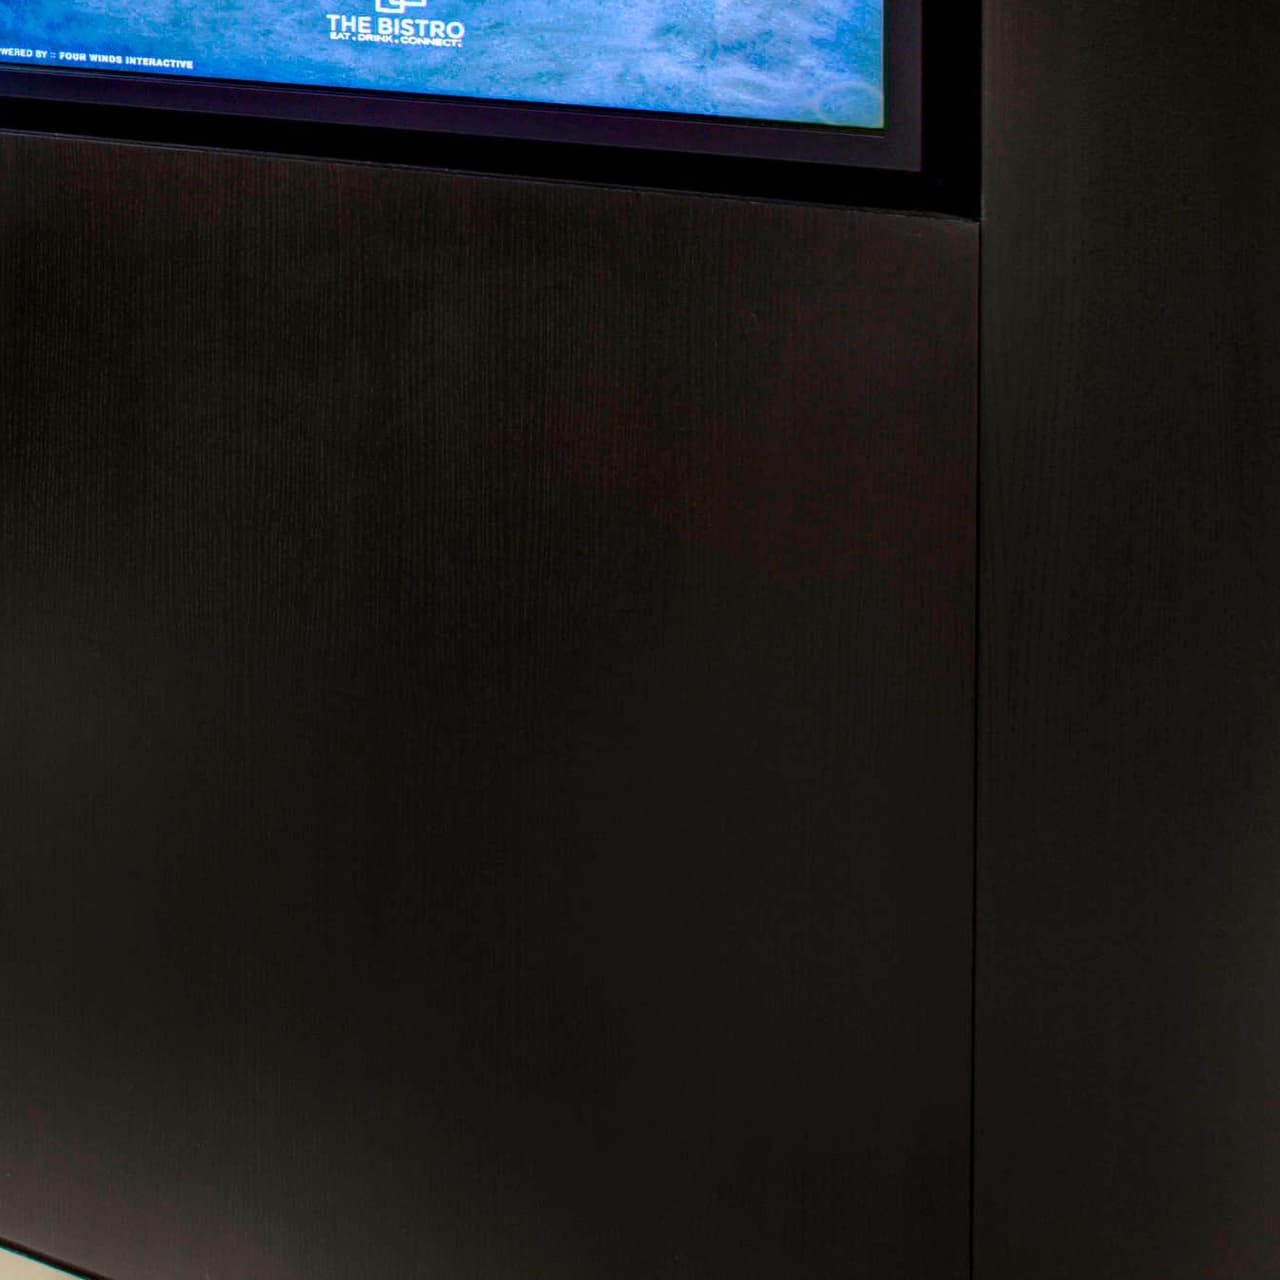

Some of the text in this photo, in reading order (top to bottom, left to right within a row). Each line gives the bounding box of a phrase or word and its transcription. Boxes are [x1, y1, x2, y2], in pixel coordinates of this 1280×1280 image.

[326, 14, 465, 39] THE BISTRO
[35, 49, 48, 59] BY
[59, 51, 87, 62] FOUR
[89, 53, 122, 65] WINDS
[125, 56, 194, 70] INTERACTIVE
